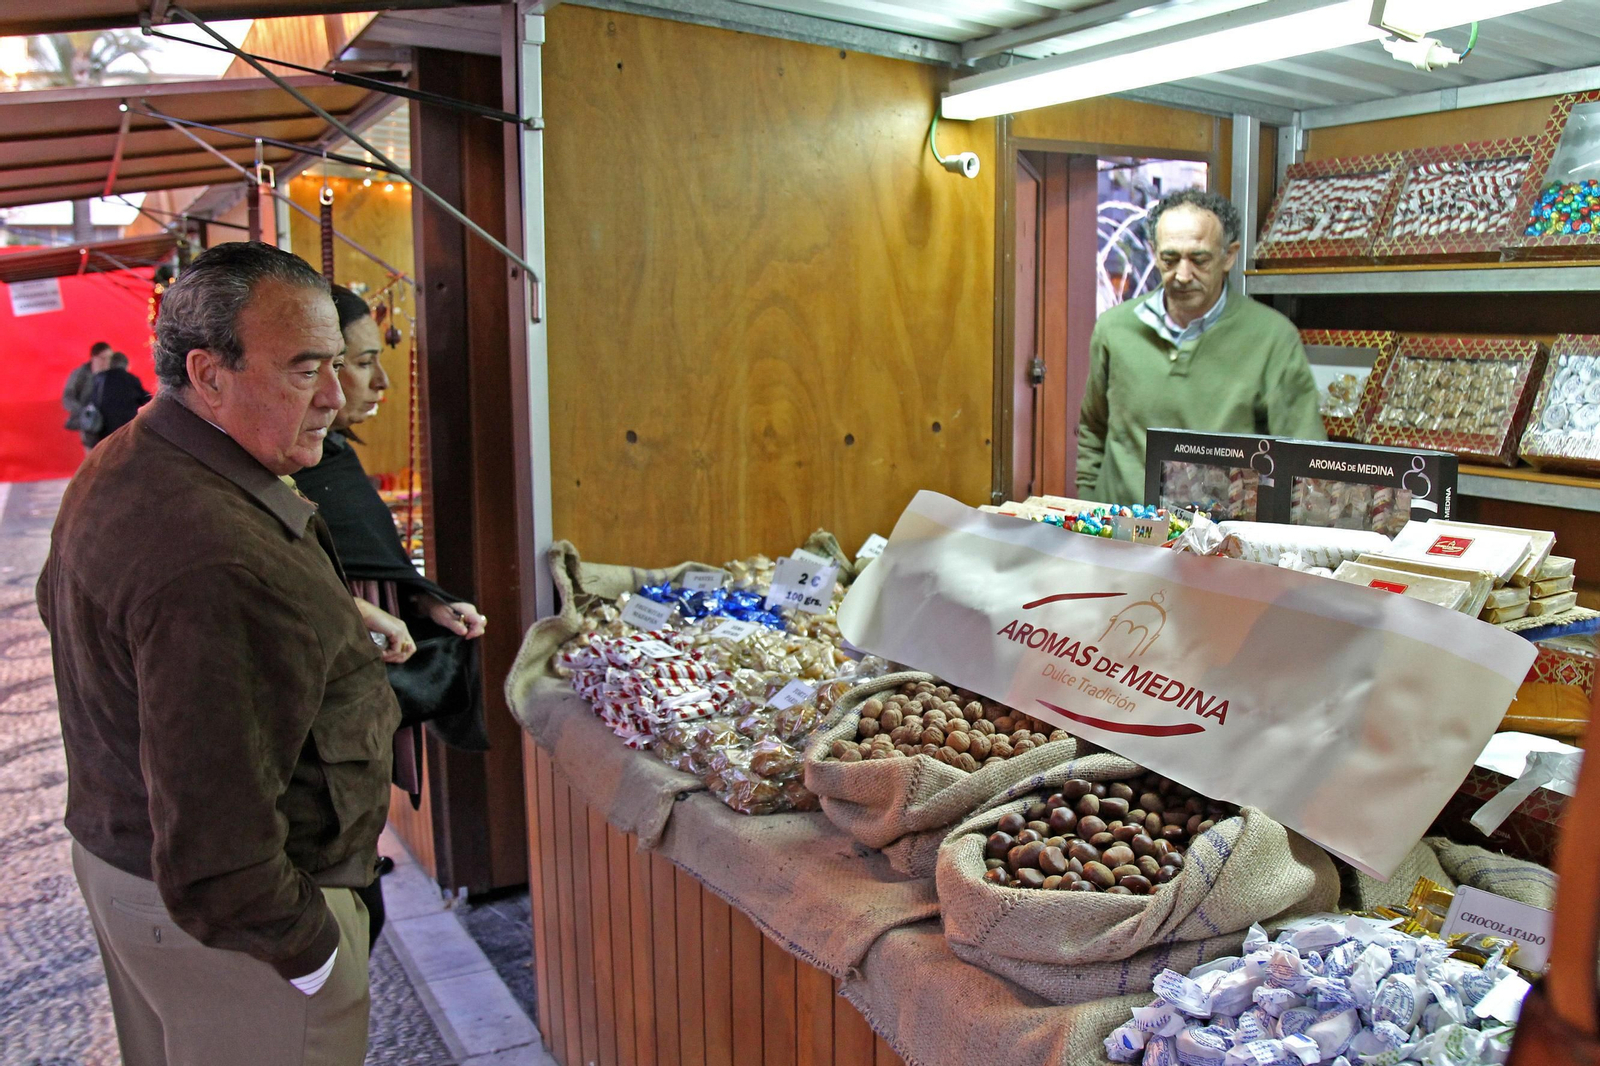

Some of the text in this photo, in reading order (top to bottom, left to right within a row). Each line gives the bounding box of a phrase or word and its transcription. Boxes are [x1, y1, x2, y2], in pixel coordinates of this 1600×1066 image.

[1174, 443, 1206, 455] AROMAS
[1213, 448, 1245, 459] MEDINA
[1308, 458, 1395, 477] AROMAS DE MEDINA
[1444, 486, 1452, 519] MEDINA
[798, 573, 821, 587] 2 €
[785, 590, 822, 607] 100 grs.
[996, 619, 1230, 726] AROMAS DE MEDINA
[1041, 663, 1137, 713] Dulce Tradición
[1460, 911, 1546, 946] CHOCOLATADO
